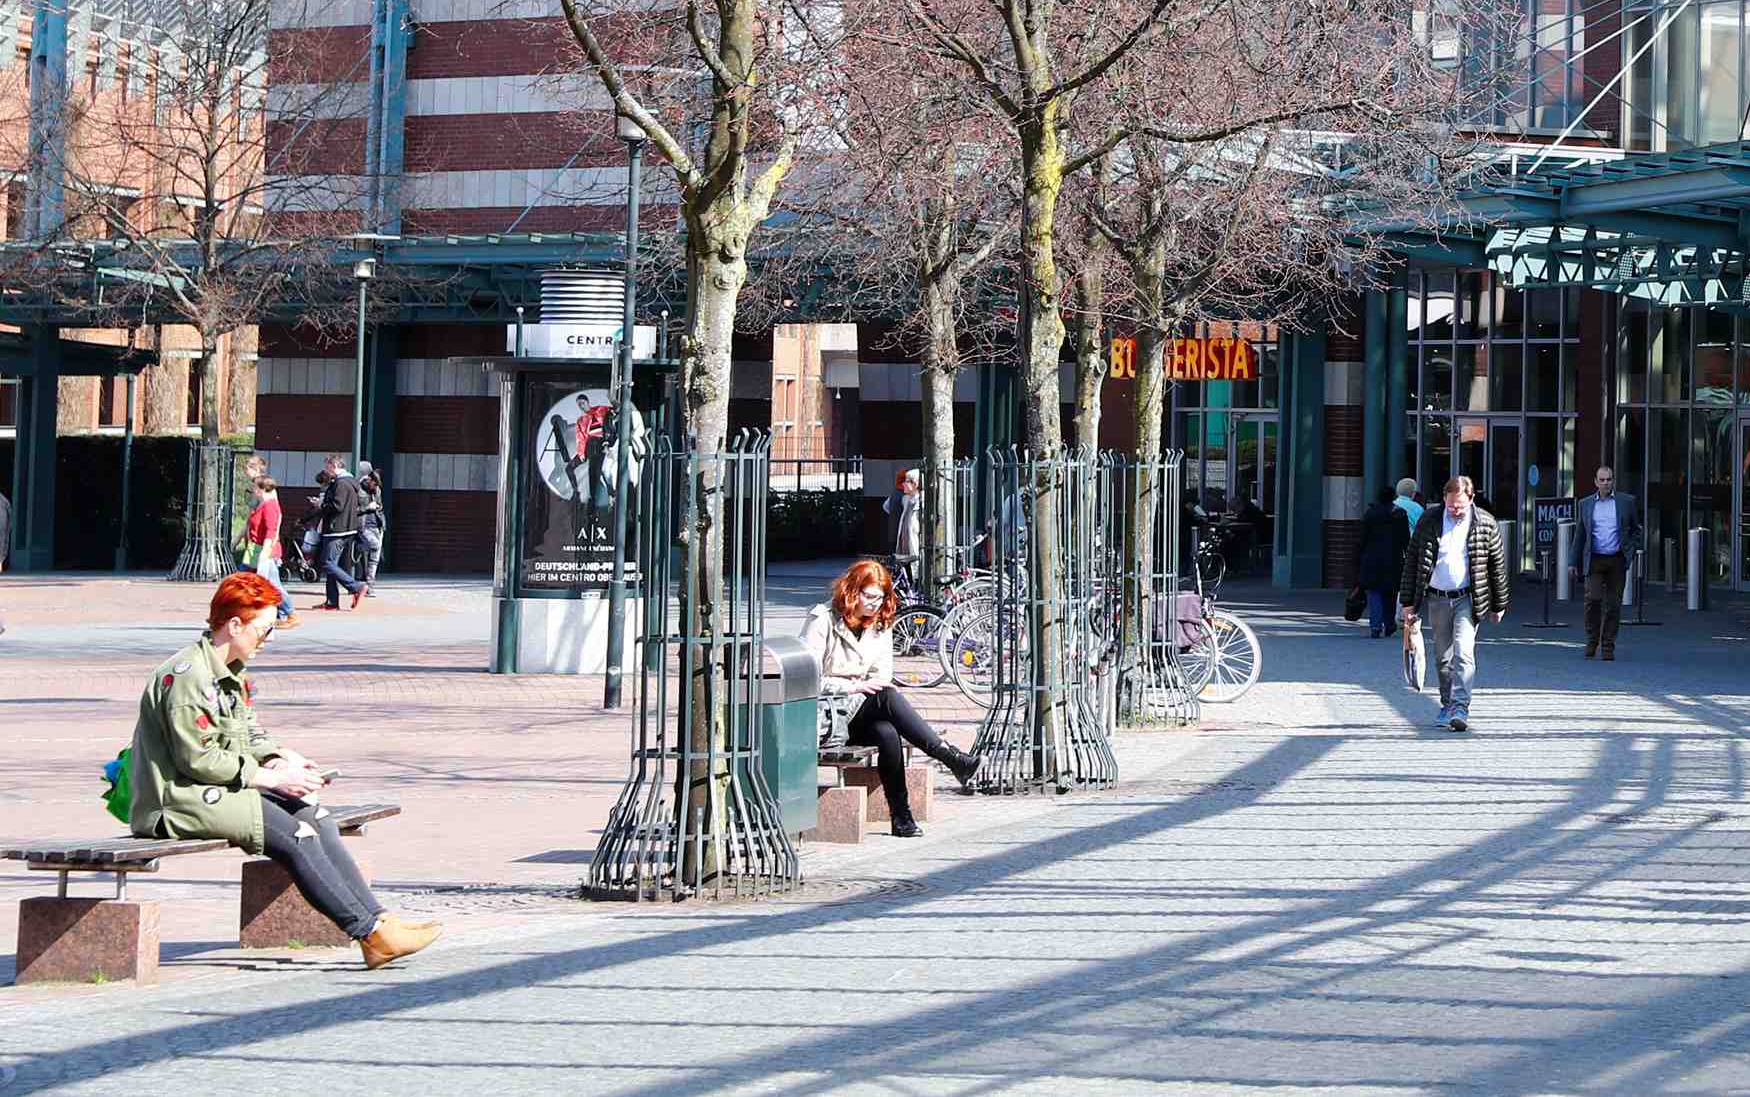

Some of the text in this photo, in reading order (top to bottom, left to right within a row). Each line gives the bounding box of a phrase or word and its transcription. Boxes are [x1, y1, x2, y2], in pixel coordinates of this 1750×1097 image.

[1110, 338, 1249, 379] BUGERISTA
[527, 573, 546, 581] HIER
[548, 573, 558, 581] IM
[560, 573, 596, 582] CENTRO
